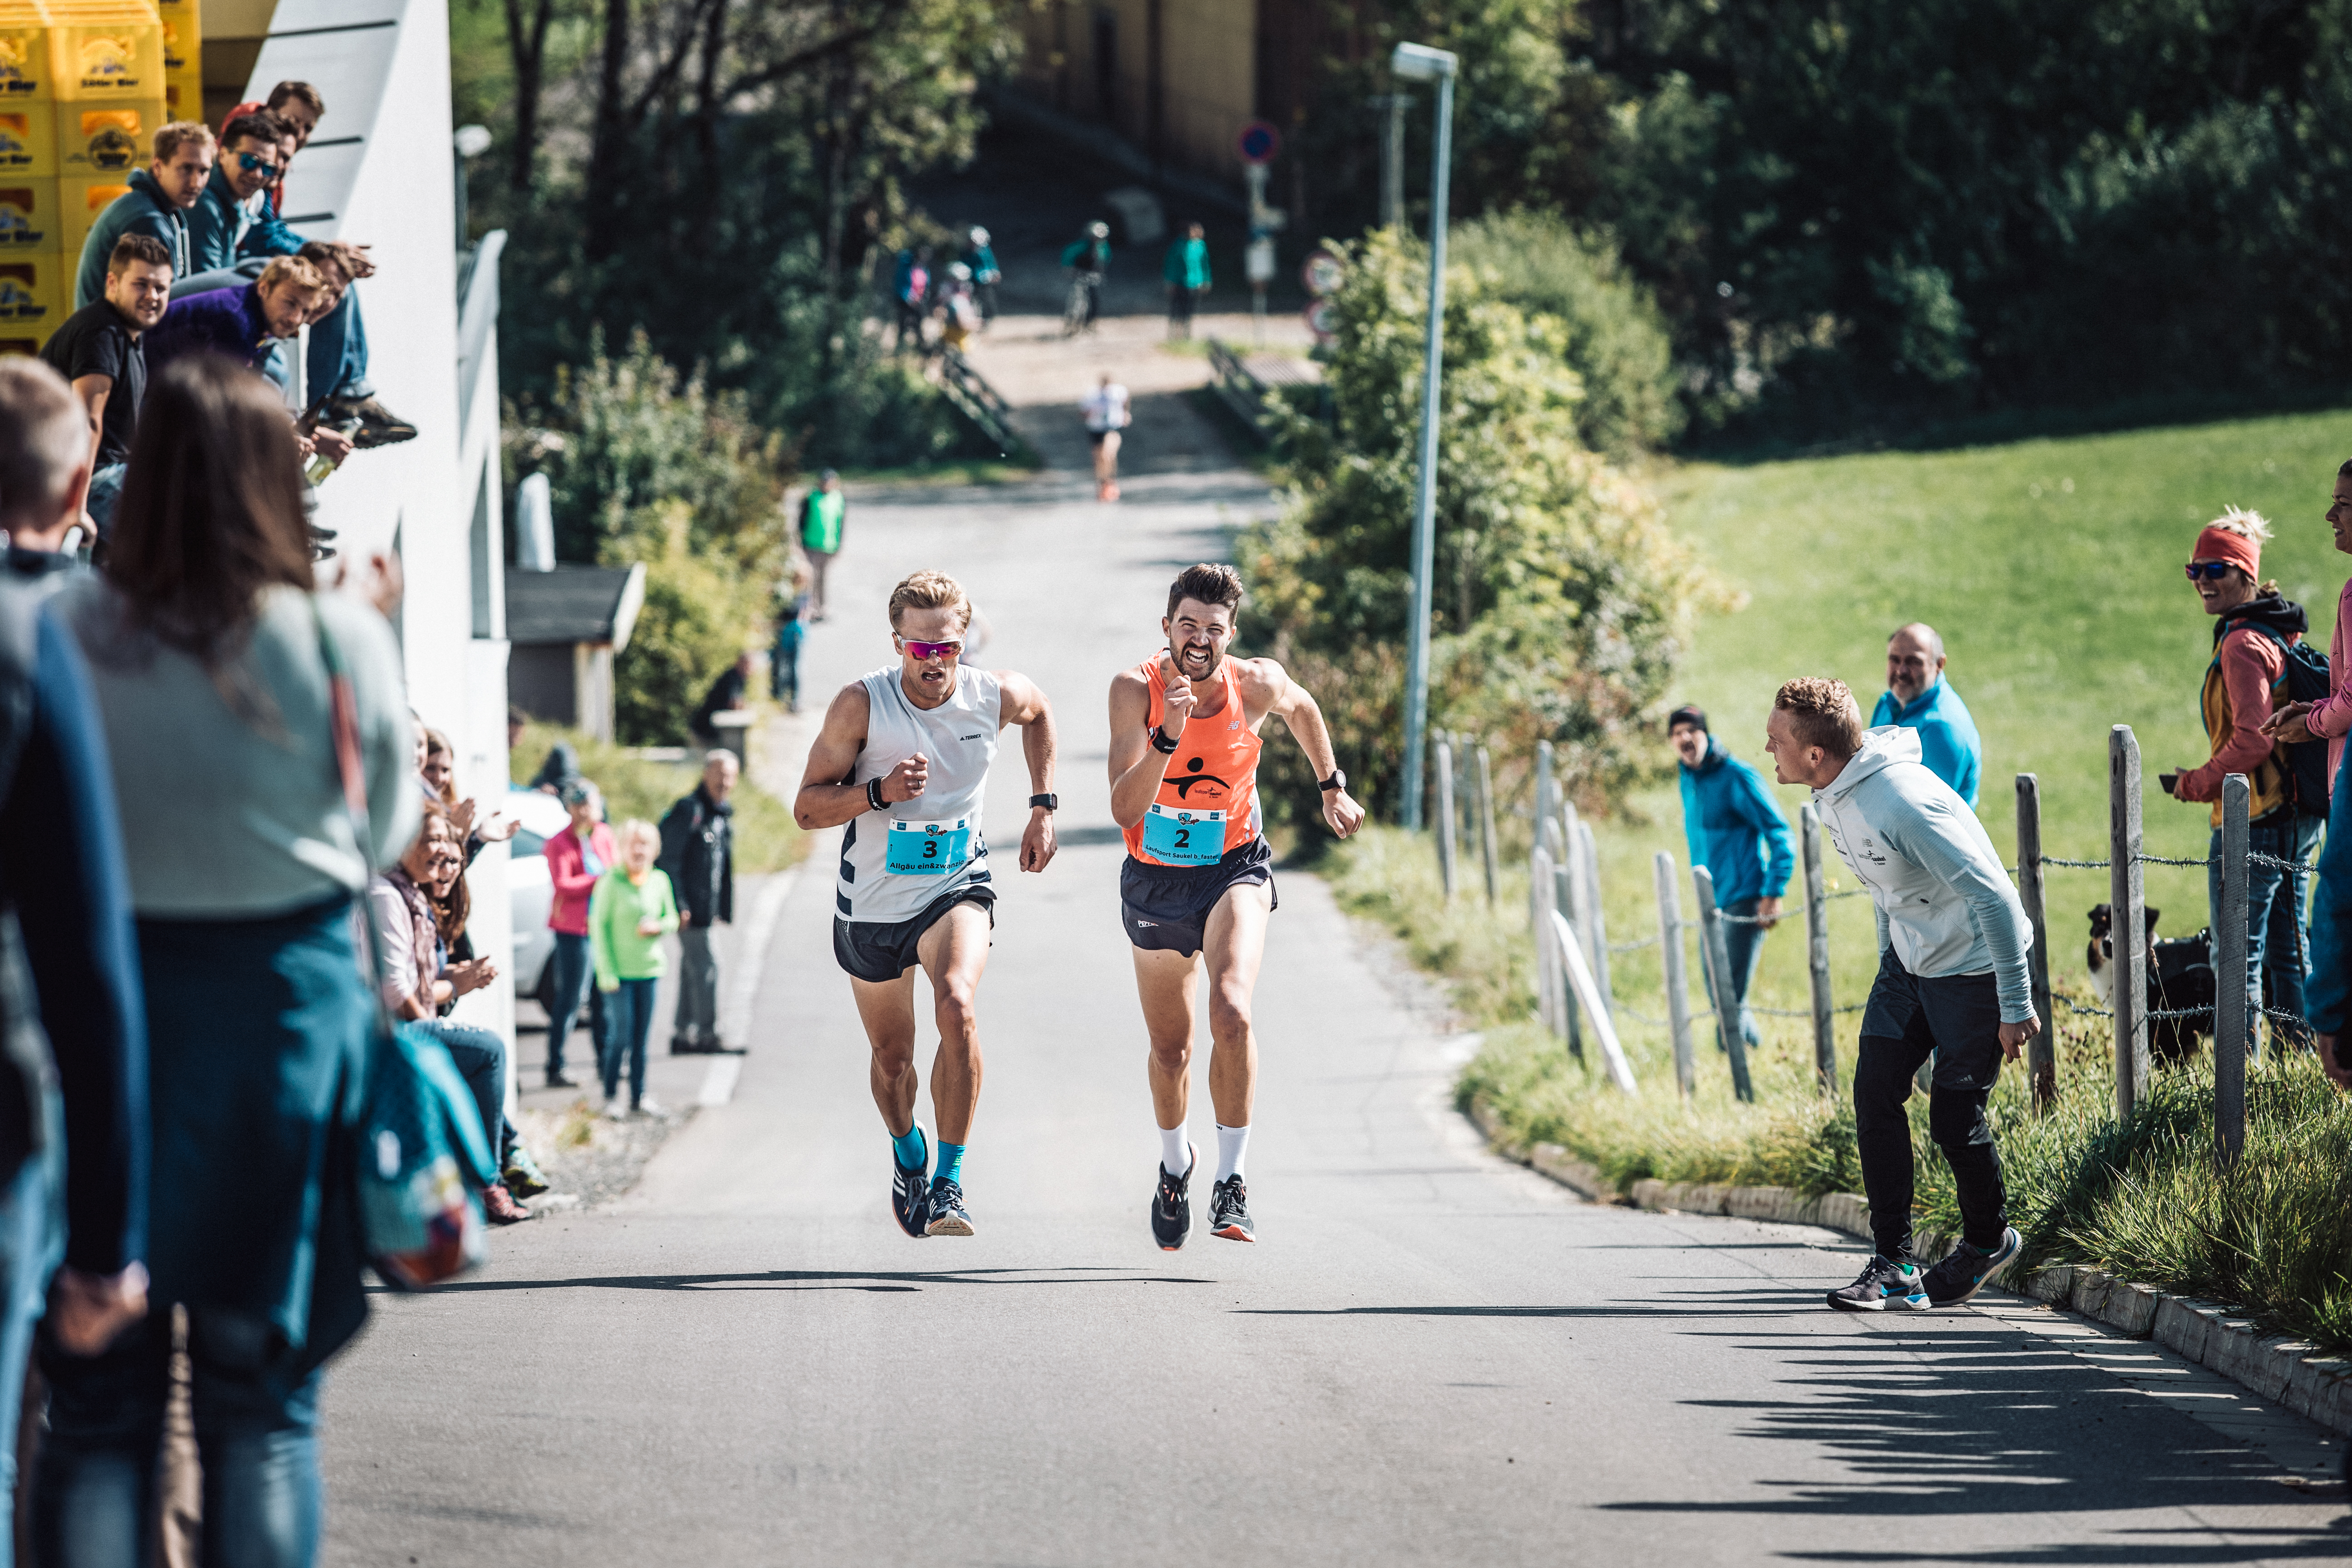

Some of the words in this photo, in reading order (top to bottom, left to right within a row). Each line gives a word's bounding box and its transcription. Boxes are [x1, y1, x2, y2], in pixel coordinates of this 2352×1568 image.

[1174, 829, 1190, 848] 2
[922, 840, 937, 858] 3
[1146, 844, 1171, 857] Laufsport
[890, 862, 915, 871] Allgäu
[917, 860, 964, 869] ein&zwanzig
